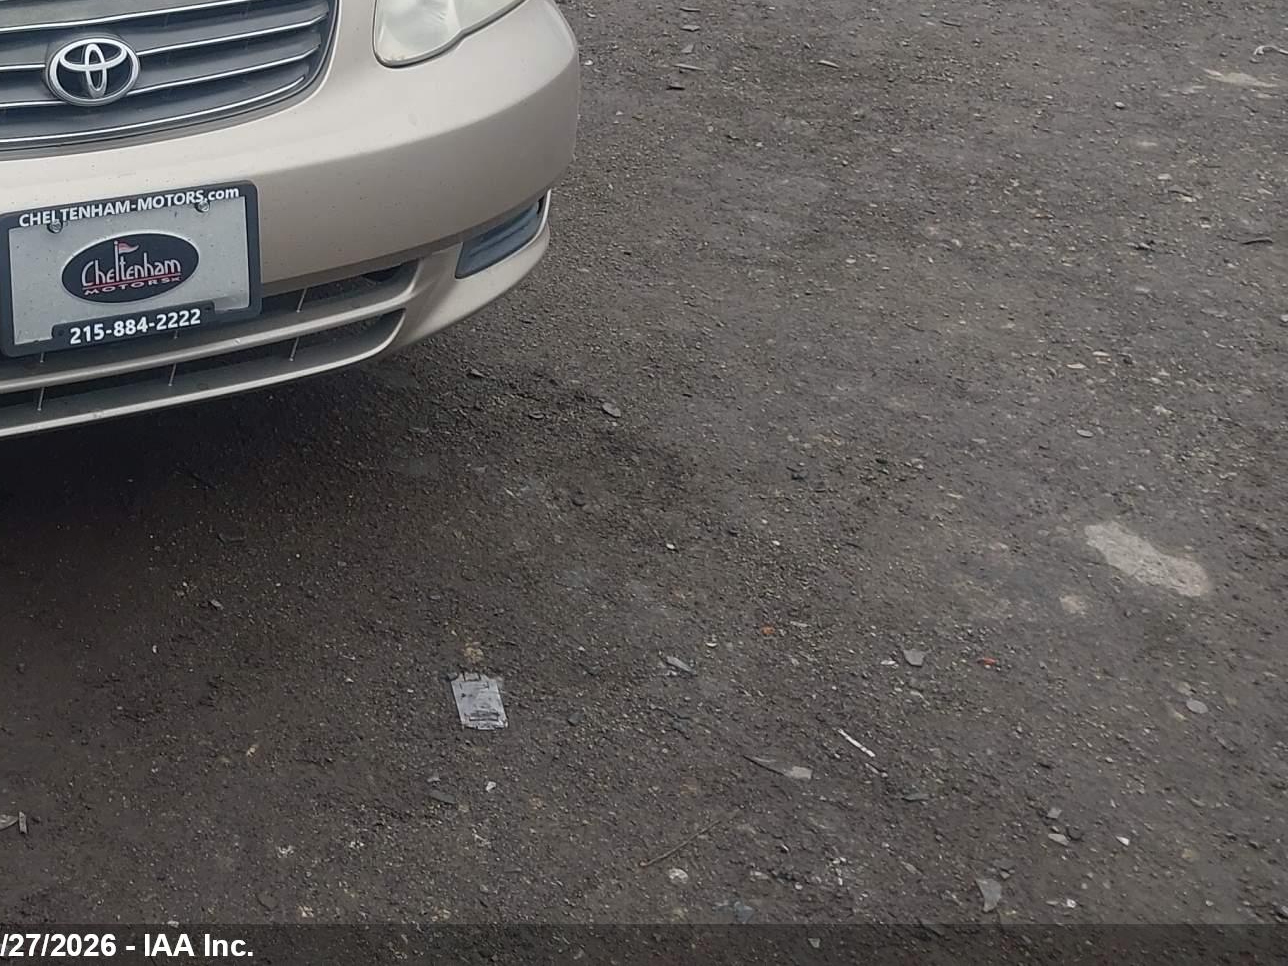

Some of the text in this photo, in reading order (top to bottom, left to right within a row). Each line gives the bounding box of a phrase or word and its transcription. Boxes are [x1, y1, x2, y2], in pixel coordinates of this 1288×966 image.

[19, 187, 240, 228] CHELTENHAM-MOTORS.com
[81, 241, 181, 287] Cheltenham
[70, 308, 201, 345] 215-884-2222
